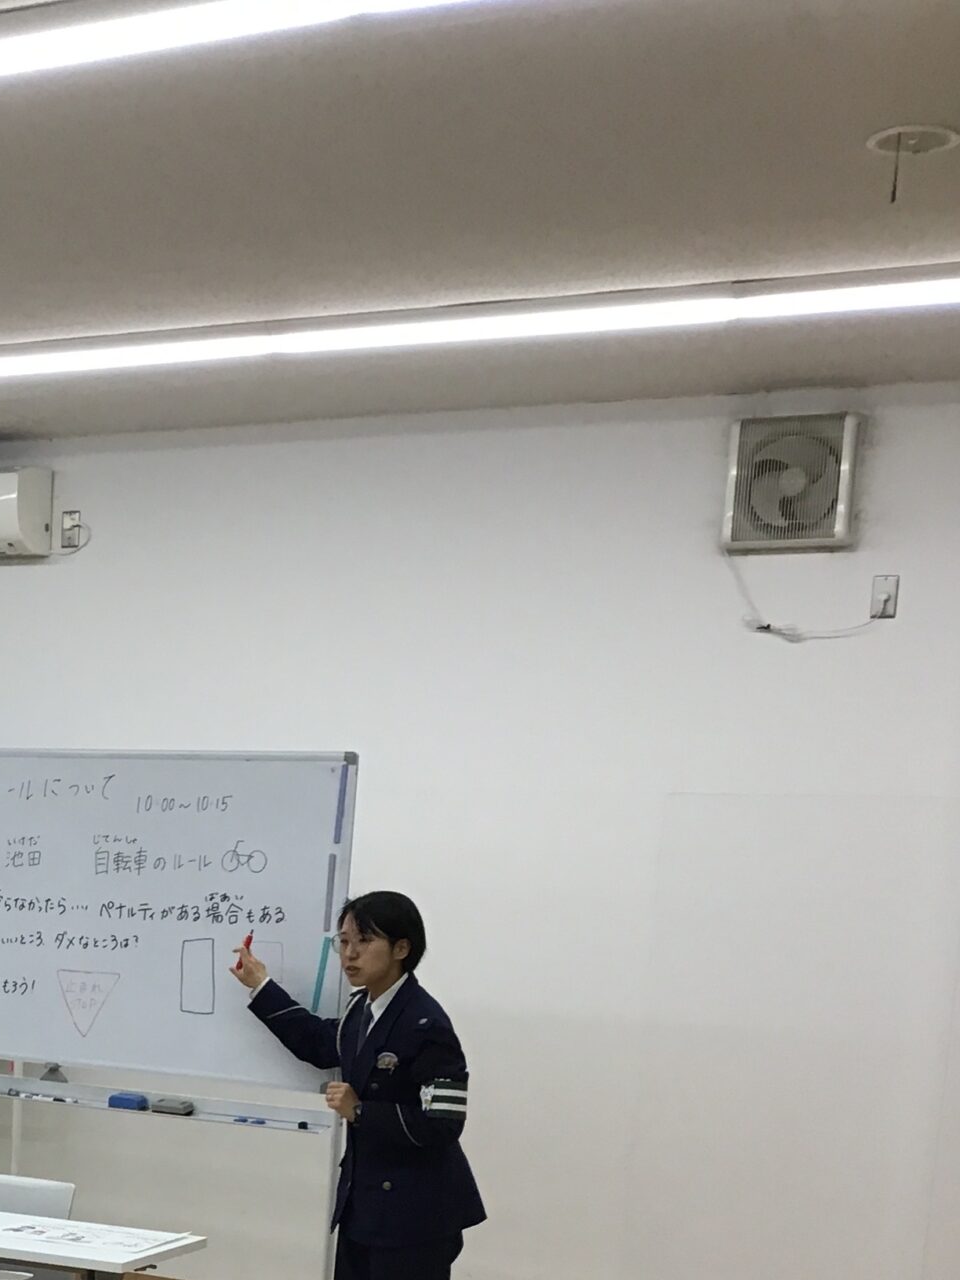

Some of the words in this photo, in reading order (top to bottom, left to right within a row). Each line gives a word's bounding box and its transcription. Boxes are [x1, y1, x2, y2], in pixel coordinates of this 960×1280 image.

[5, 849, 42, 868] 池田
[94, 847, 213, 876] 自転車のルール
